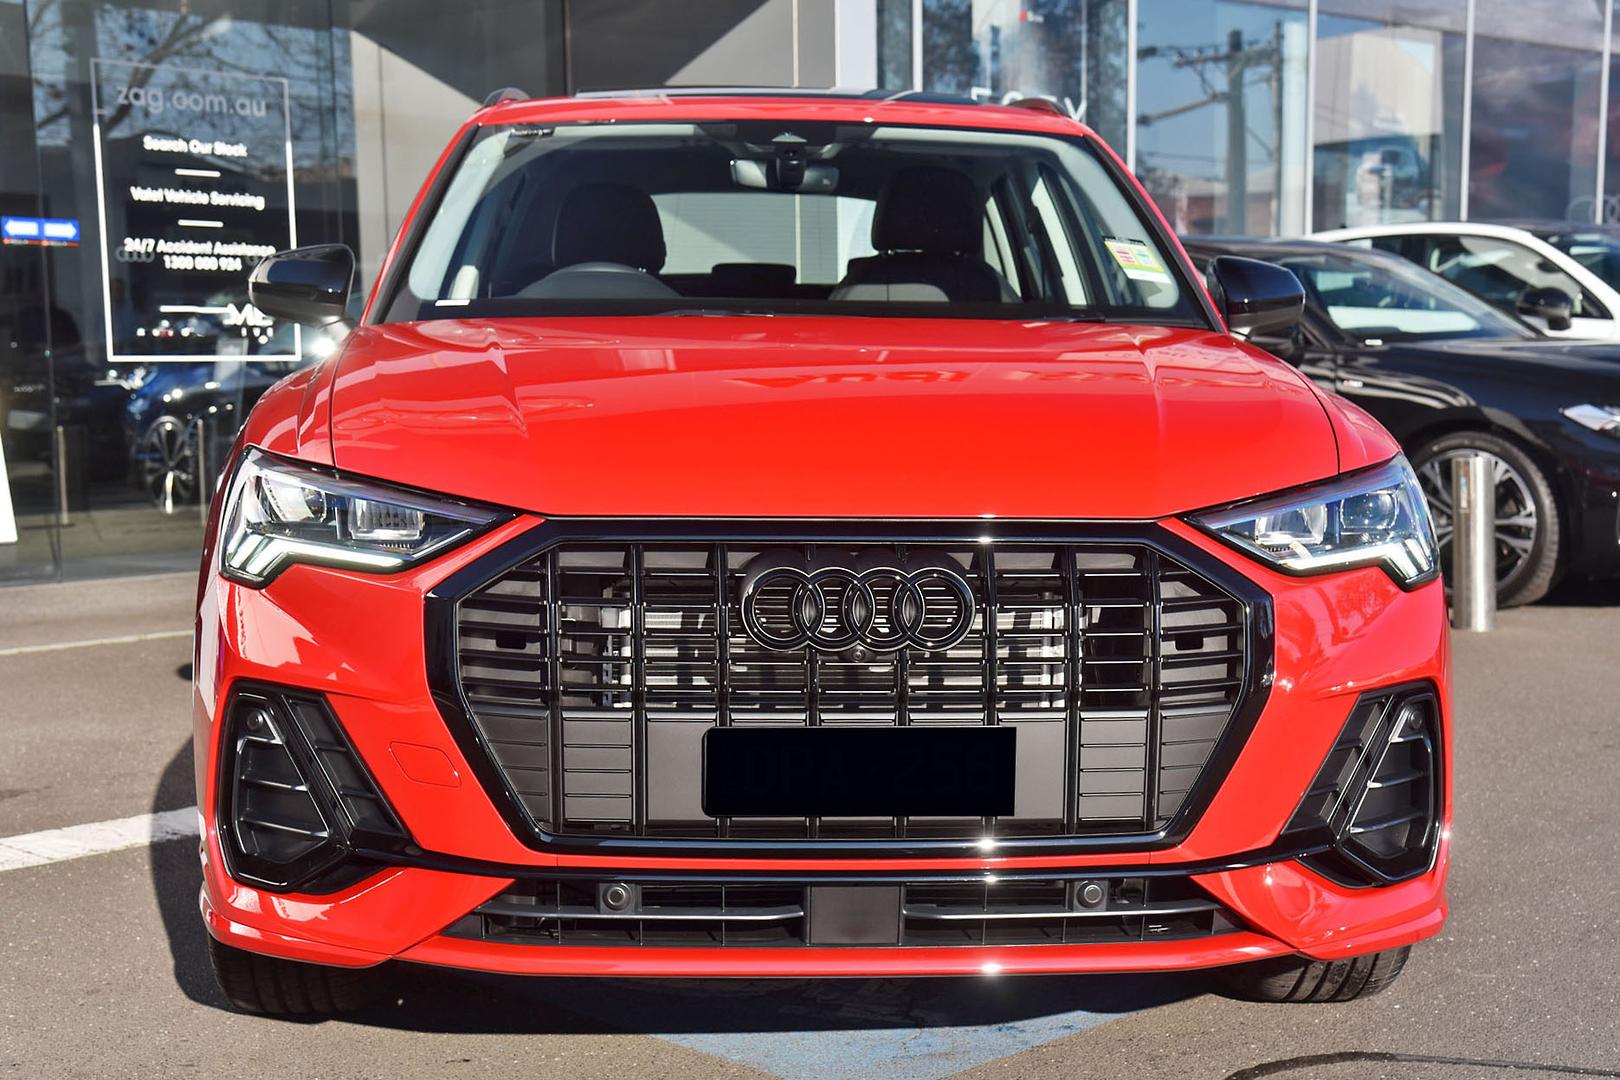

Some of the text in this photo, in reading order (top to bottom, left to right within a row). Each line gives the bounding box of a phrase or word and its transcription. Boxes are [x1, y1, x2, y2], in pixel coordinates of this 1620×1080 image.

[188, 139, 213, 154] Our
[210, 191, 265, 211] Servicing
[123, 237, 155, 253] 24/7
[156, 239, 213, 254] Accident
